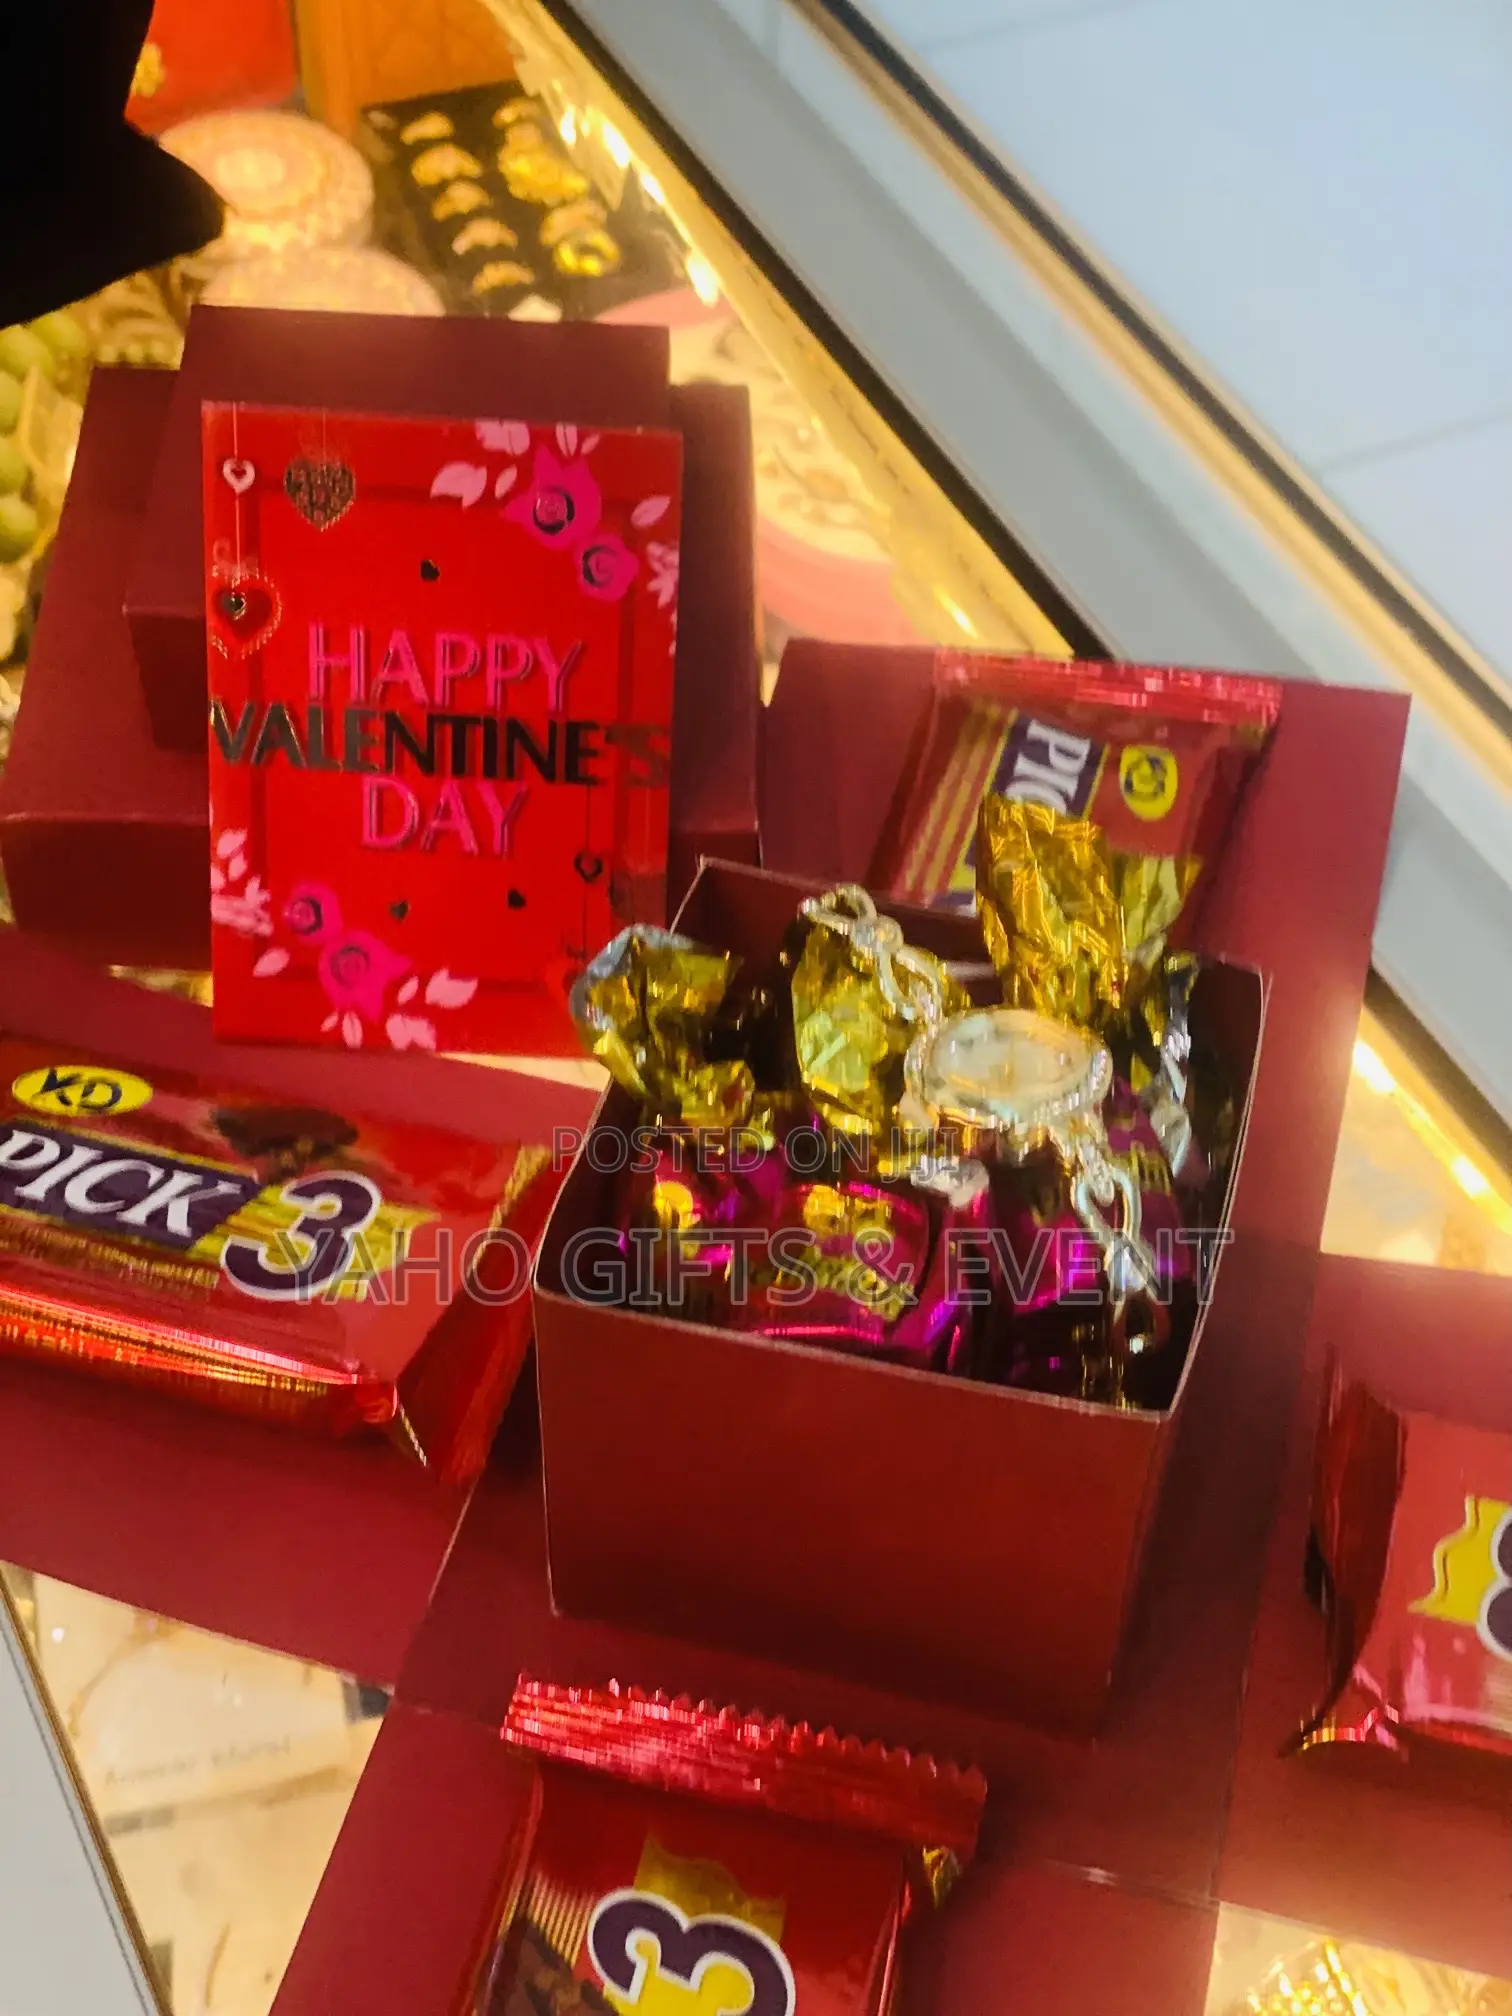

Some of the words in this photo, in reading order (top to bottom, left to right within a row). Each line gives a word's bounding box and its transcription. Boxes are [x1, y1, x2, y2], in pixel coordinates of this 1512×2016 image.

[307, 623, 582, 712] HAPPY
[361, 773, 527, 857] DAY
[31, 1066, 123, 1113] KD
[0, 1129, 242, 1237] PICK
[220, 1171, 381, 1300] 3
